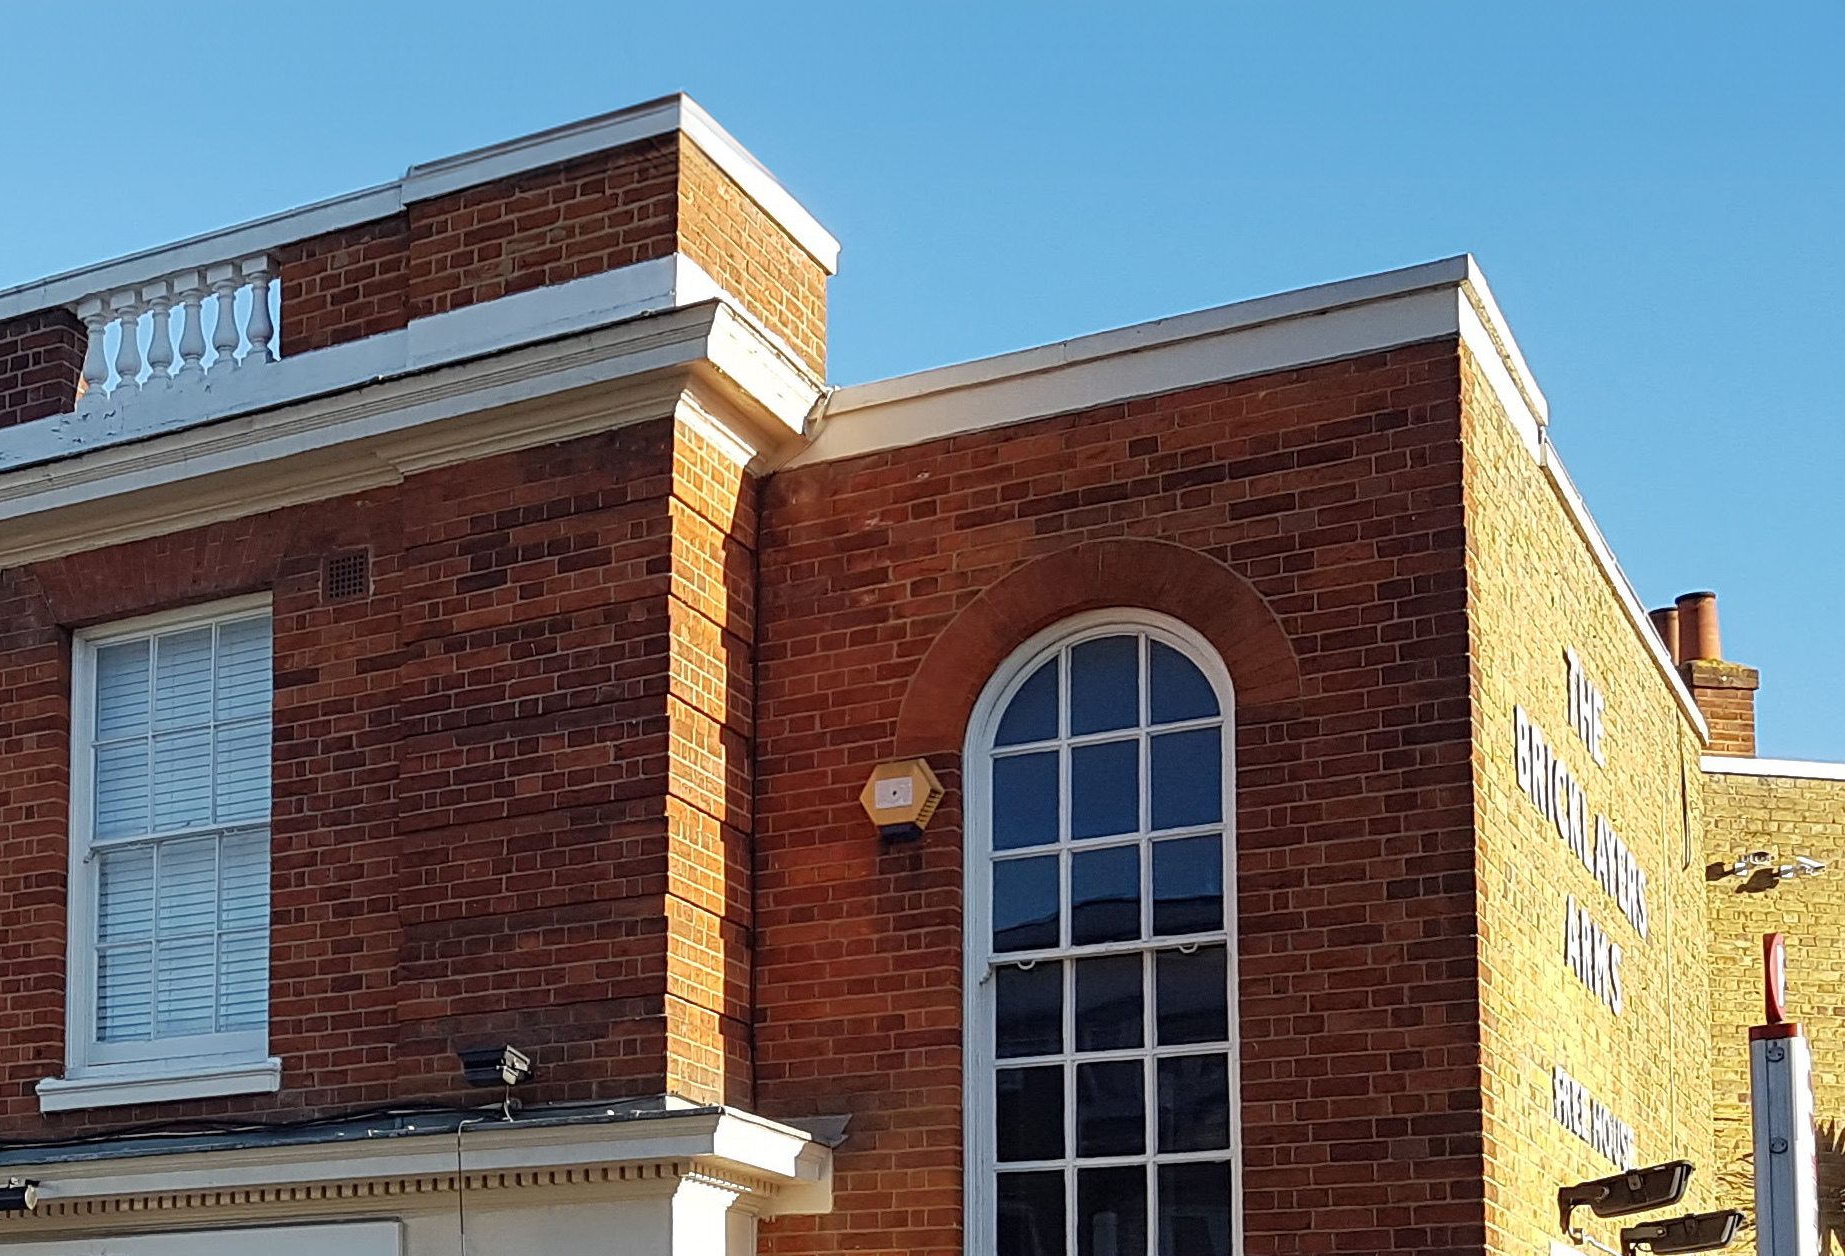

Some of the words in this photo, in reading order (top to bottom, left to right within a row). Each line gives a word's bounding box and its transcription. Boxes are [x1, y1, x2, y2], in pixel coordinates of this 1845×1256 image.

[1563, 645, 1605, 769] THE
[1514, 703, 1648, 940] BRICKLAYERS
[1564, 893, 1623, 1018] ARMS
[1552, 1063, 1591, 1145] FREE
